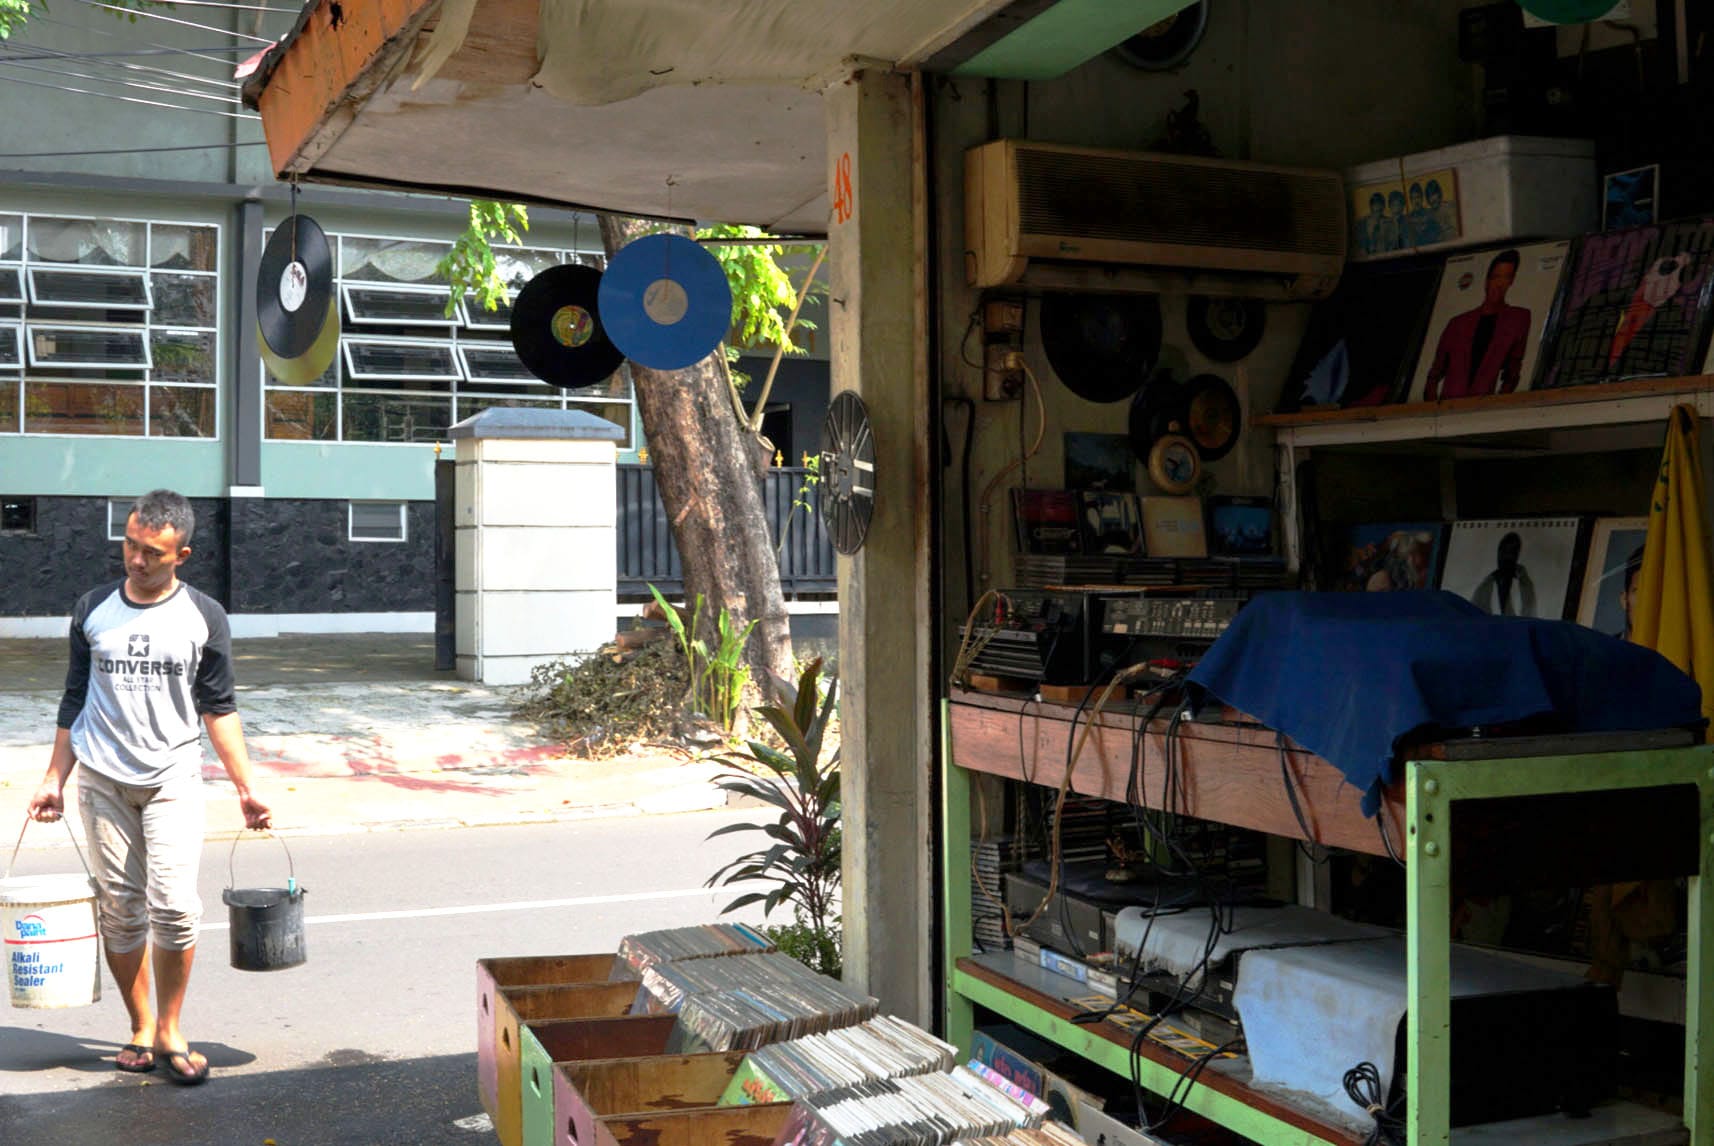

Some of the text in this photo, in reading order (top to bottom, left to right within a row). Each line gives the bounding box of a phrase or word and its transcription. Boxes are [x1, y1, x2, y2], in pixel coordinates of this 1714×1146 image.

[833, 152, 853, 225] 48
[98, 659, 184, 677] CONVERSE
[12, 951, 40, 963] Alkali
[12, 962, 64, 975] Resistant
[13, 974, 46, 987] Sealer
